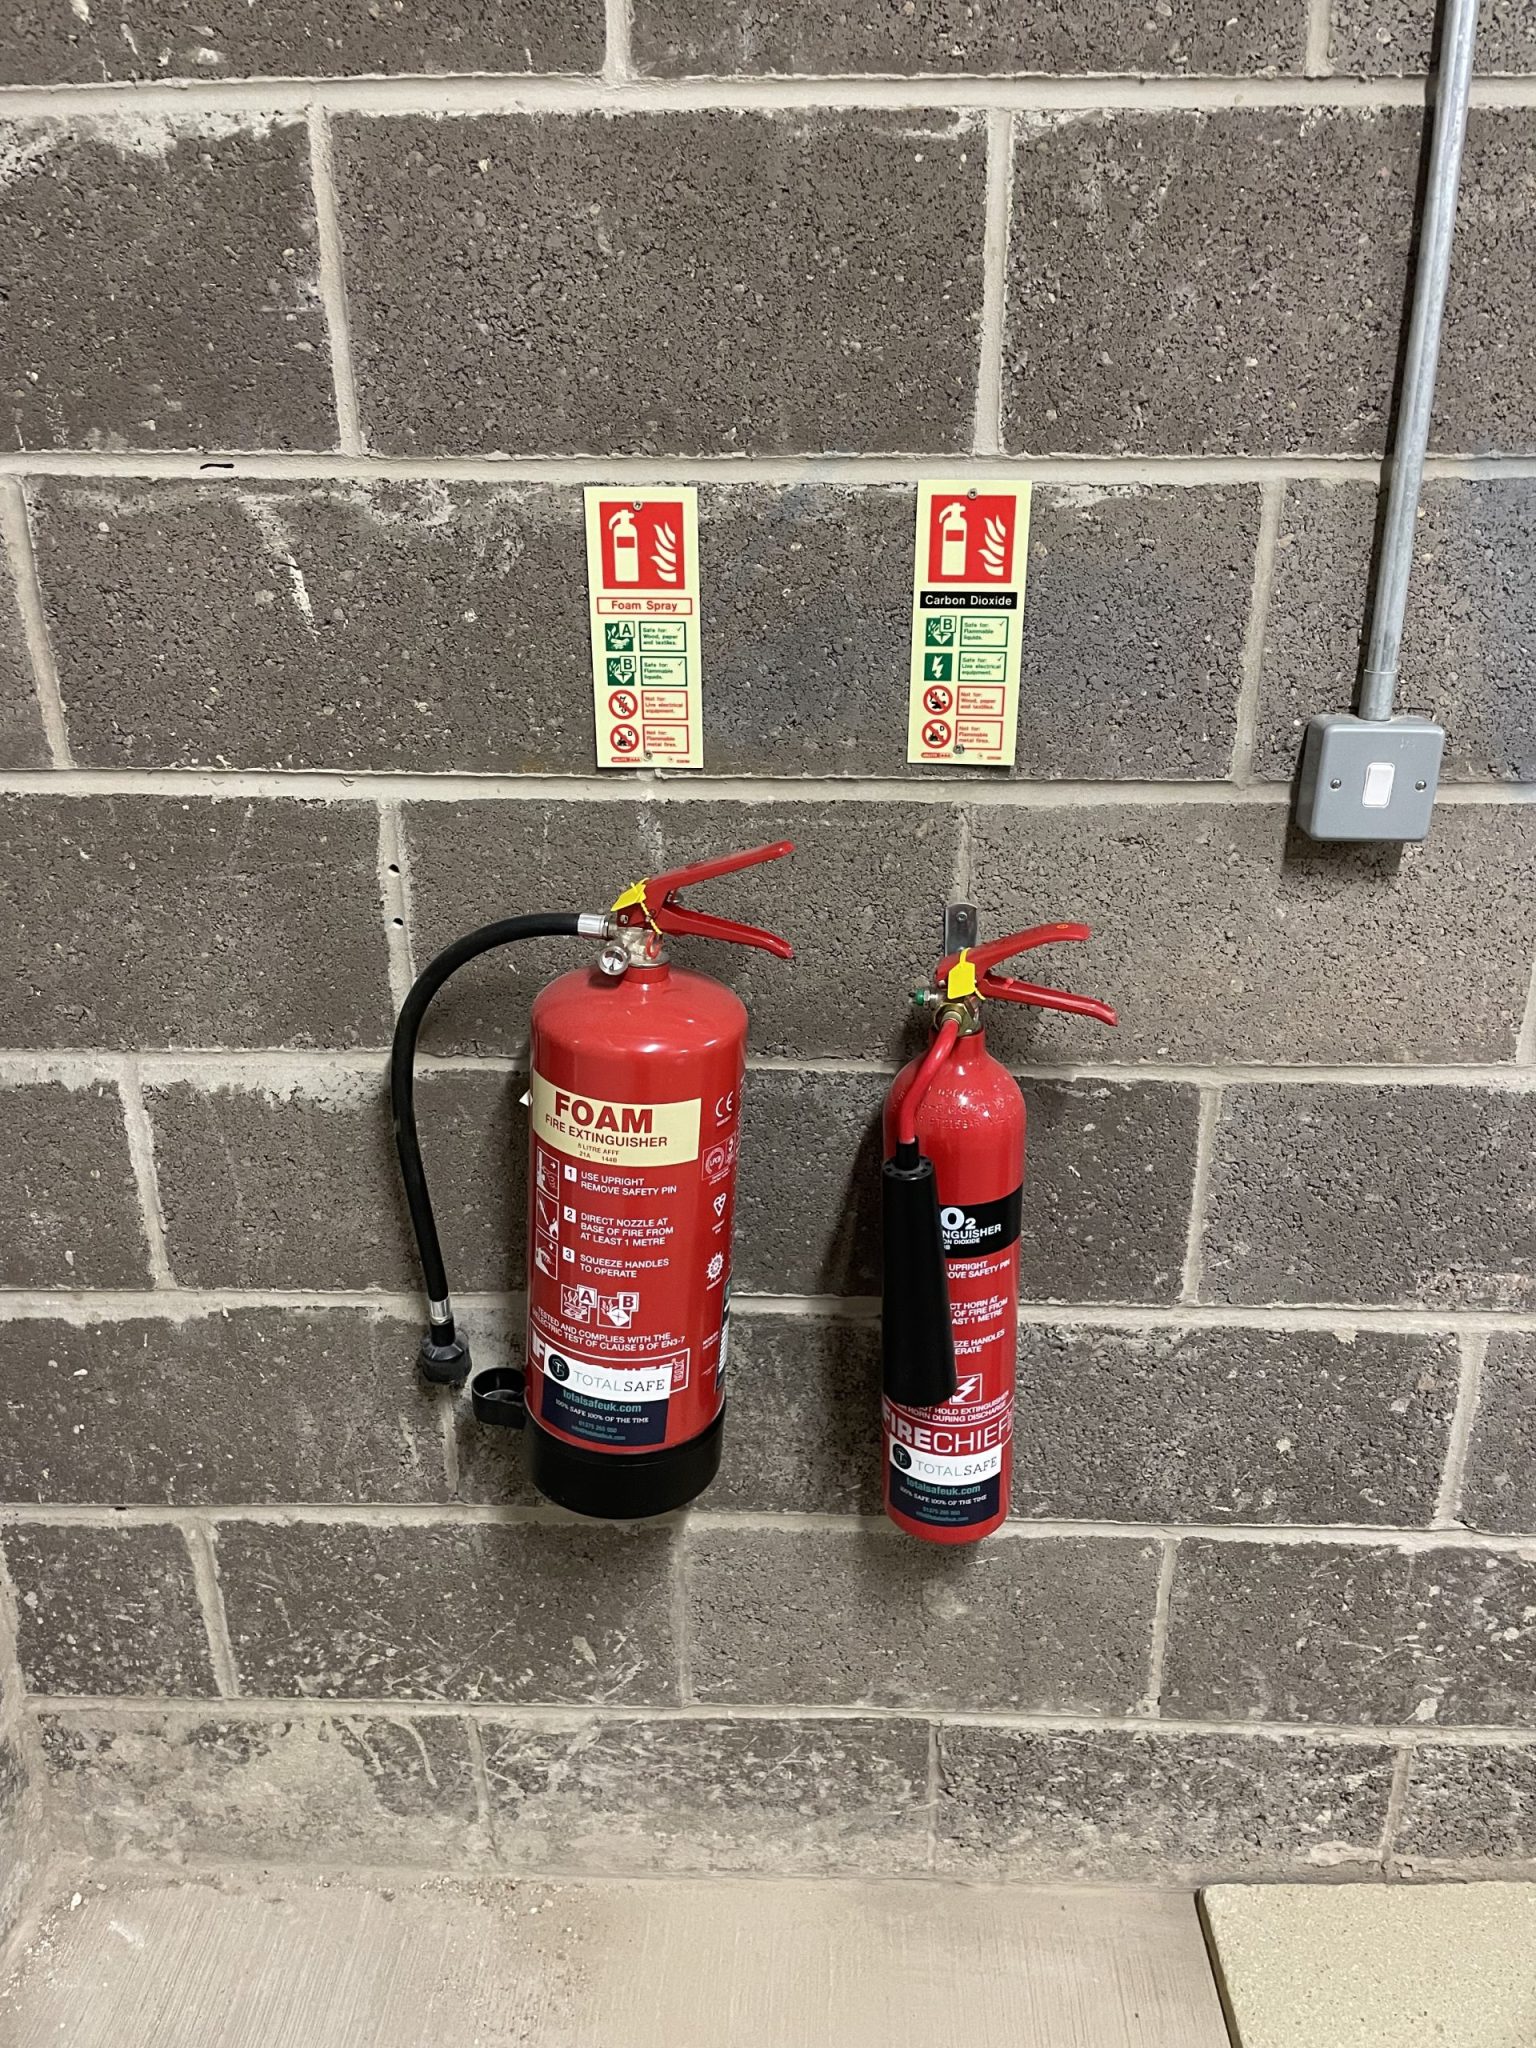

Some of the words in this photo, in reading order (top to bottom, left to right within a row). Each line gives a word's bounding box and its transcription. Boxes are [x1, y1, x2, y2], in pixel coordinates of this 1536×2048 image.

[611, 600, 641, 610] Foam
[646, 600, 678, 612] Spray
[925, 595, 966, 605] Carbon
[970, 595, 1012, 606] Dioxide
[622, 624, 632, 635] A
[943, 618, 953, 630] B
[623, 659, 633, 670] B
[555, 1091, 653, 1133] FOAM
[545, 1113, 566, 1133] FIRE
[569, 1126, 668, 1147] EXTINGUISHER
[582, 1144, 601, 1153] LITRE
[568, 1169, 573, 1178] 1
[581, 1171, 599, 1182] USE
[601, 1175, 644, 1186] UPRIGHT
[581, 1181, 620, 1195] REMOVE
[622, 1187, 659, 1196] SAFETY
[661, 1186, 677, 1194] PIN
[567, 1209, 573, 1219] 2
[581, 1212, 614, 1225] DIRECT
[616, 1219, 655, 1227] NOZZLE
[657, 1218, 668, 1226] AT
[940, 1207, 976, 1231] O2
[581, 1222, 604, 1234] BASE
[607, 1227, 620, 1236] OF
[622, 1229, 644, 1237] FIRE
[646, 1227, 674, 1236] FROM
[942, 1223, 1002, 1239] NGUISHER
[580, 1232, 591, 1241] AT
[593, 1235, 622, 1245] LEAST
[632, 1237, 665, 1246] METRE
[565, 1250, 571, 1259] 3
[580, 1254, 622, 1268] SQUEEZE
[625, 1258, 669, 1268] HANDLES
[949, 1260, 988, 1271] UPRIGHT
[580, 1263, 592, 1273] TO
[594, 1266, 637, 1278] OPERATE
[947, 1271, 966, 1279] OVE
[968, 1264, 1000, 1278] SAFETY
[580, 1290, 593, 1304] A
[623, 1295, 634, 1308] B
[963, 1299, 988, 1309] HORN
[989, 1295, 999, 1305] AT
[968, 1306, 987, 1316] FIRE
[988, 1296, 1009, 1312] FROM
[537, 1305, 560, 1327] TESTED
[560, 1323, 577, 1335] AND
[578, 1329, 625, 1343] COMPLIES
[627, 1335, 651, 1343] WITH
[653, 1332, 671, 1341] THE
[952, 1317, 969, 1325] AST
[977, 1307, 1003, 1323] METRE
[564, 1331, 583, 1345] TEST
[585, 1339, 598, 1348] OF
[600, 1342, 637, 1351] CLAUSE
[646, 1341, 658, 1350] OF
[661, 1335, 685, 1348] EN3-7
[971, 1328, 1005, 1346] HANDLES
[955, 1346, 982, 1355] ERATE
[573, 1370, 665, 1392] TOTALSAFE
[562, 1389, 642, 1413] totalsafeuk.com
[934, 1407, 959, 1415] HOLD
[960, 1390, 1009, 1414] EXTINGUISHER
[570, 1407, 587, 1417] SAFE
[587, 1412, 603, 1421] 100%
[632, 1416, 649, 1424] TIME
[908, 1406, 931, 1420] HORN
[932, 1413, 966, 1423] DURING
[967, 1400, 1007, 1421] DISCHARGE
[882, 1401, 1008, 1453] FIRECHIEF
[915, 1456, 998, 1476] TOTALSAFE
[906, 1477, 981, 1496] totalsafeuk.com
